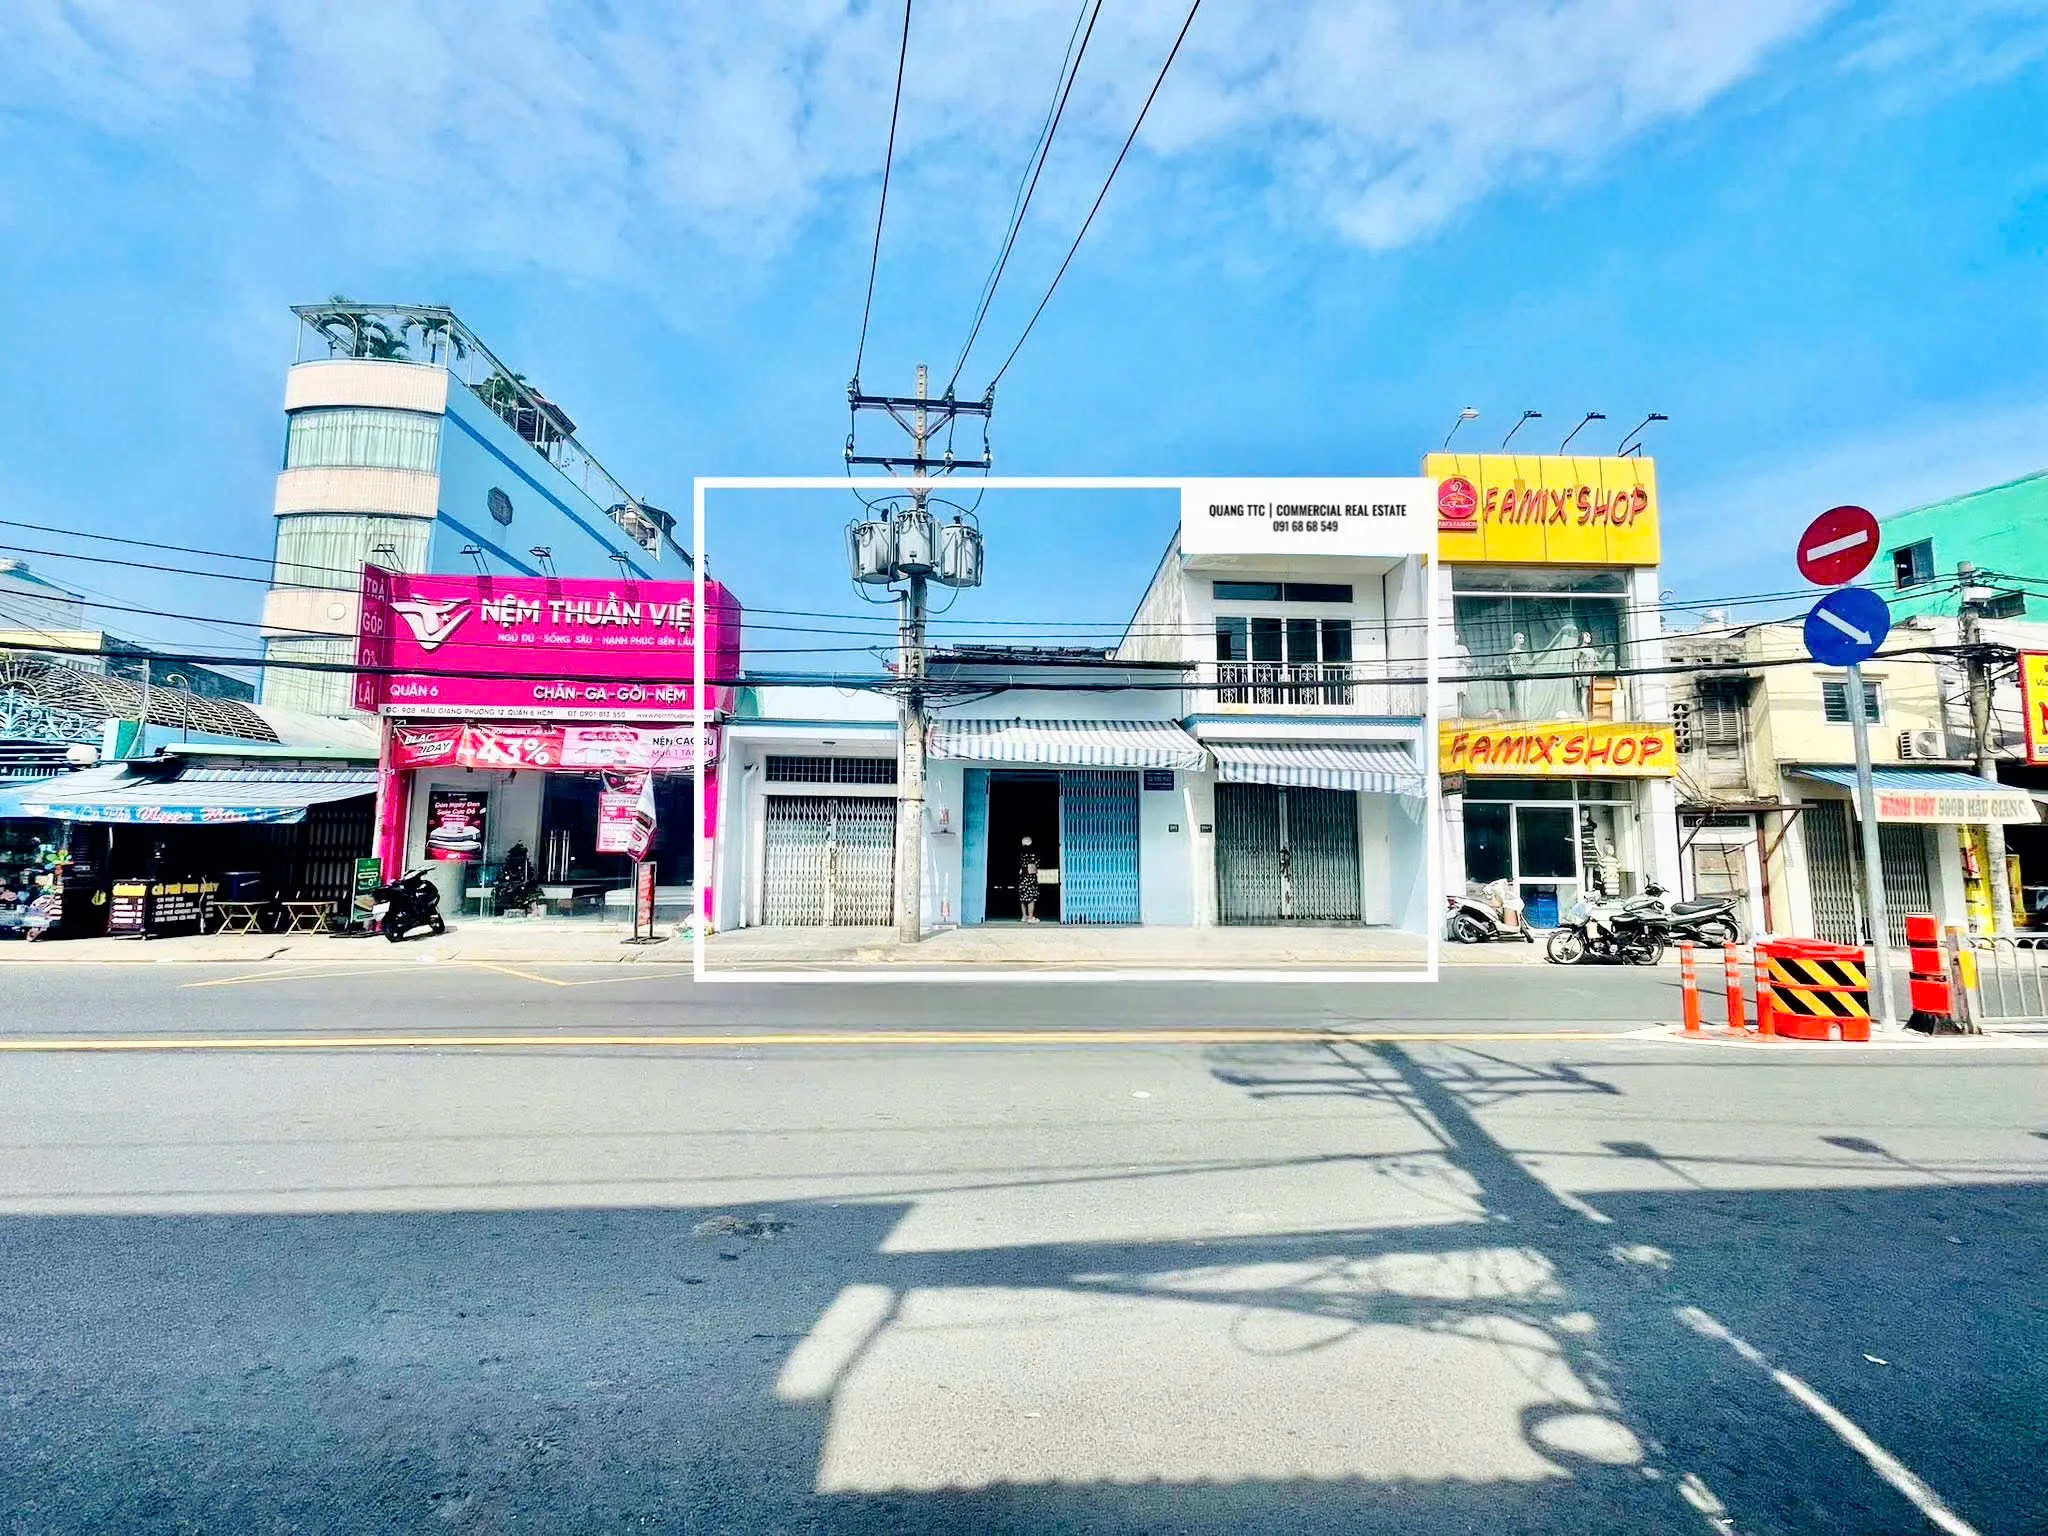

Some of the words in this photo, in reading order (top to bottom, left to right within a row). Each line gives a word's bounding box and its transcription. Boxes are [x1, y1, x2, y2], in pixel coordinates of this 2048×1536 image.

[366, 578, 385, 601] TRẢ
[362, 611, 384, 636] GÓP
[480, 593, 541, 628] NỆM
[648, 598, 708, 633] VIỆ
[429, 685, 439, 697] 6
[1991, 798, 2030, 818] GIANG
